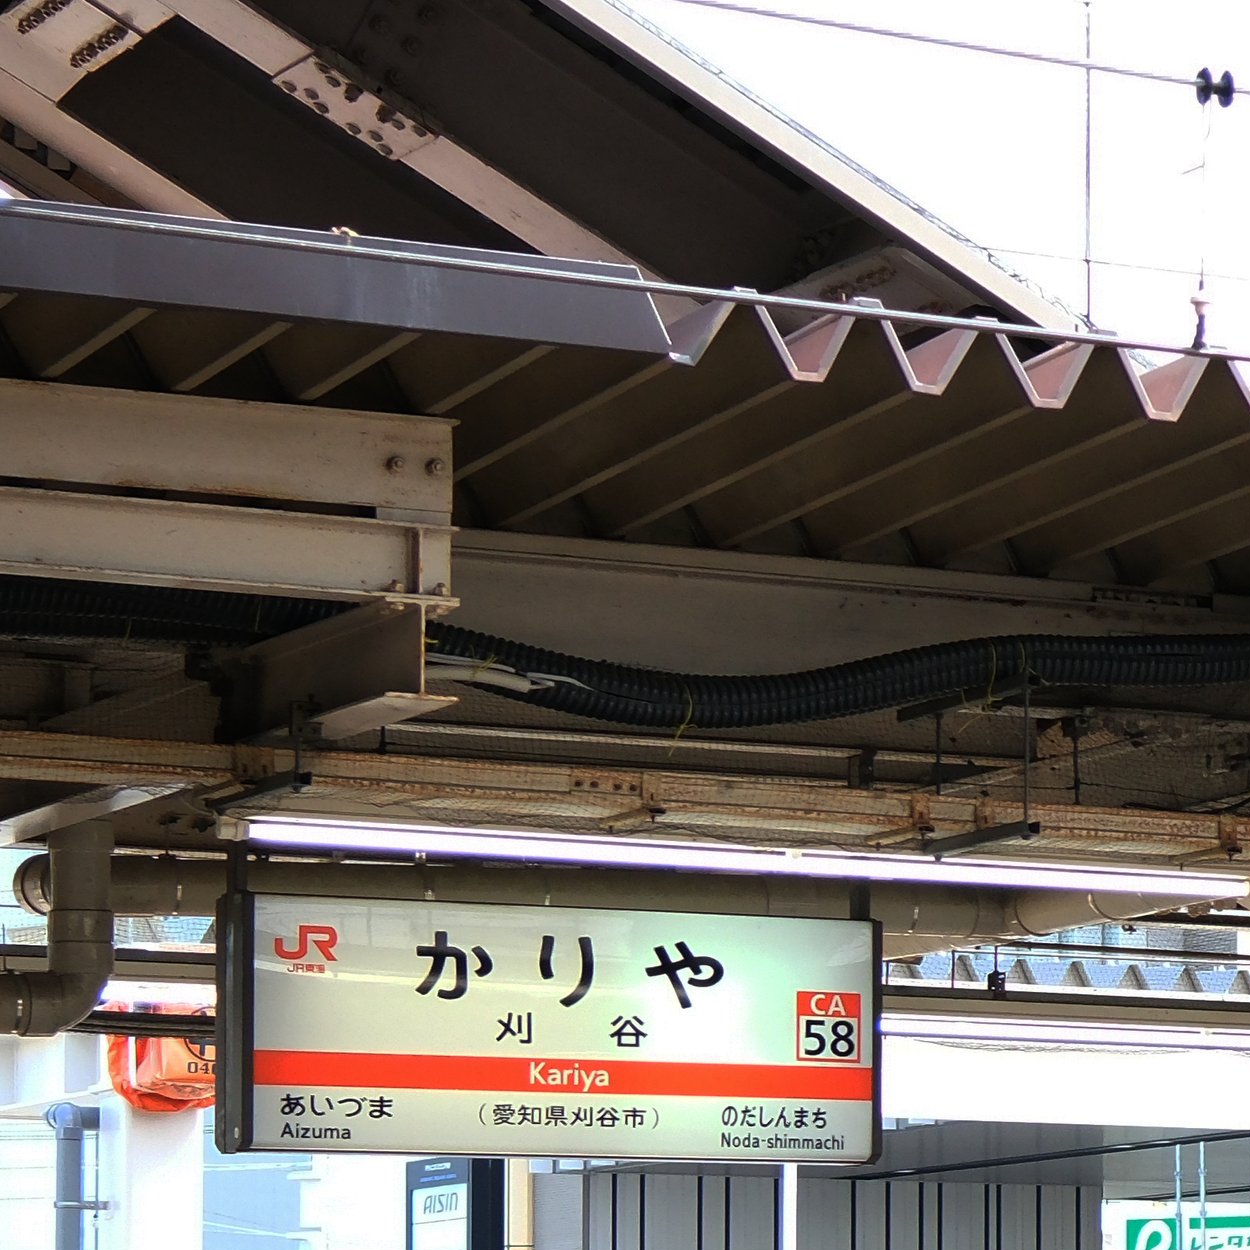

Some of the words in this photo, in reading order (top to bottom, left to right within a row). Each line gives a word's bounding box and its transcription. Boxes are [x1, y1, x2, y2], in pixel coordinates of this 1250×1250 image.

[274, 925, 338, 961] JR
[414, 930, 725, 1009] かりや
[809, 993, 847, 1016] CA
[495, 1011, 649, 1048] 刈谷
[804, 1019, 855, 1057] 58
[529, 1061, 610, 1093] Kariya
[280, 1093, 393, 1119] あいづま
[721, 1105, 827, 1129] のだしんまち
[280, 1121, 352, 1140] Aizuma
[720, 1132, 845, 1151] Noda-shimmachi
[423, 1192, 459, 1215] AISIN
